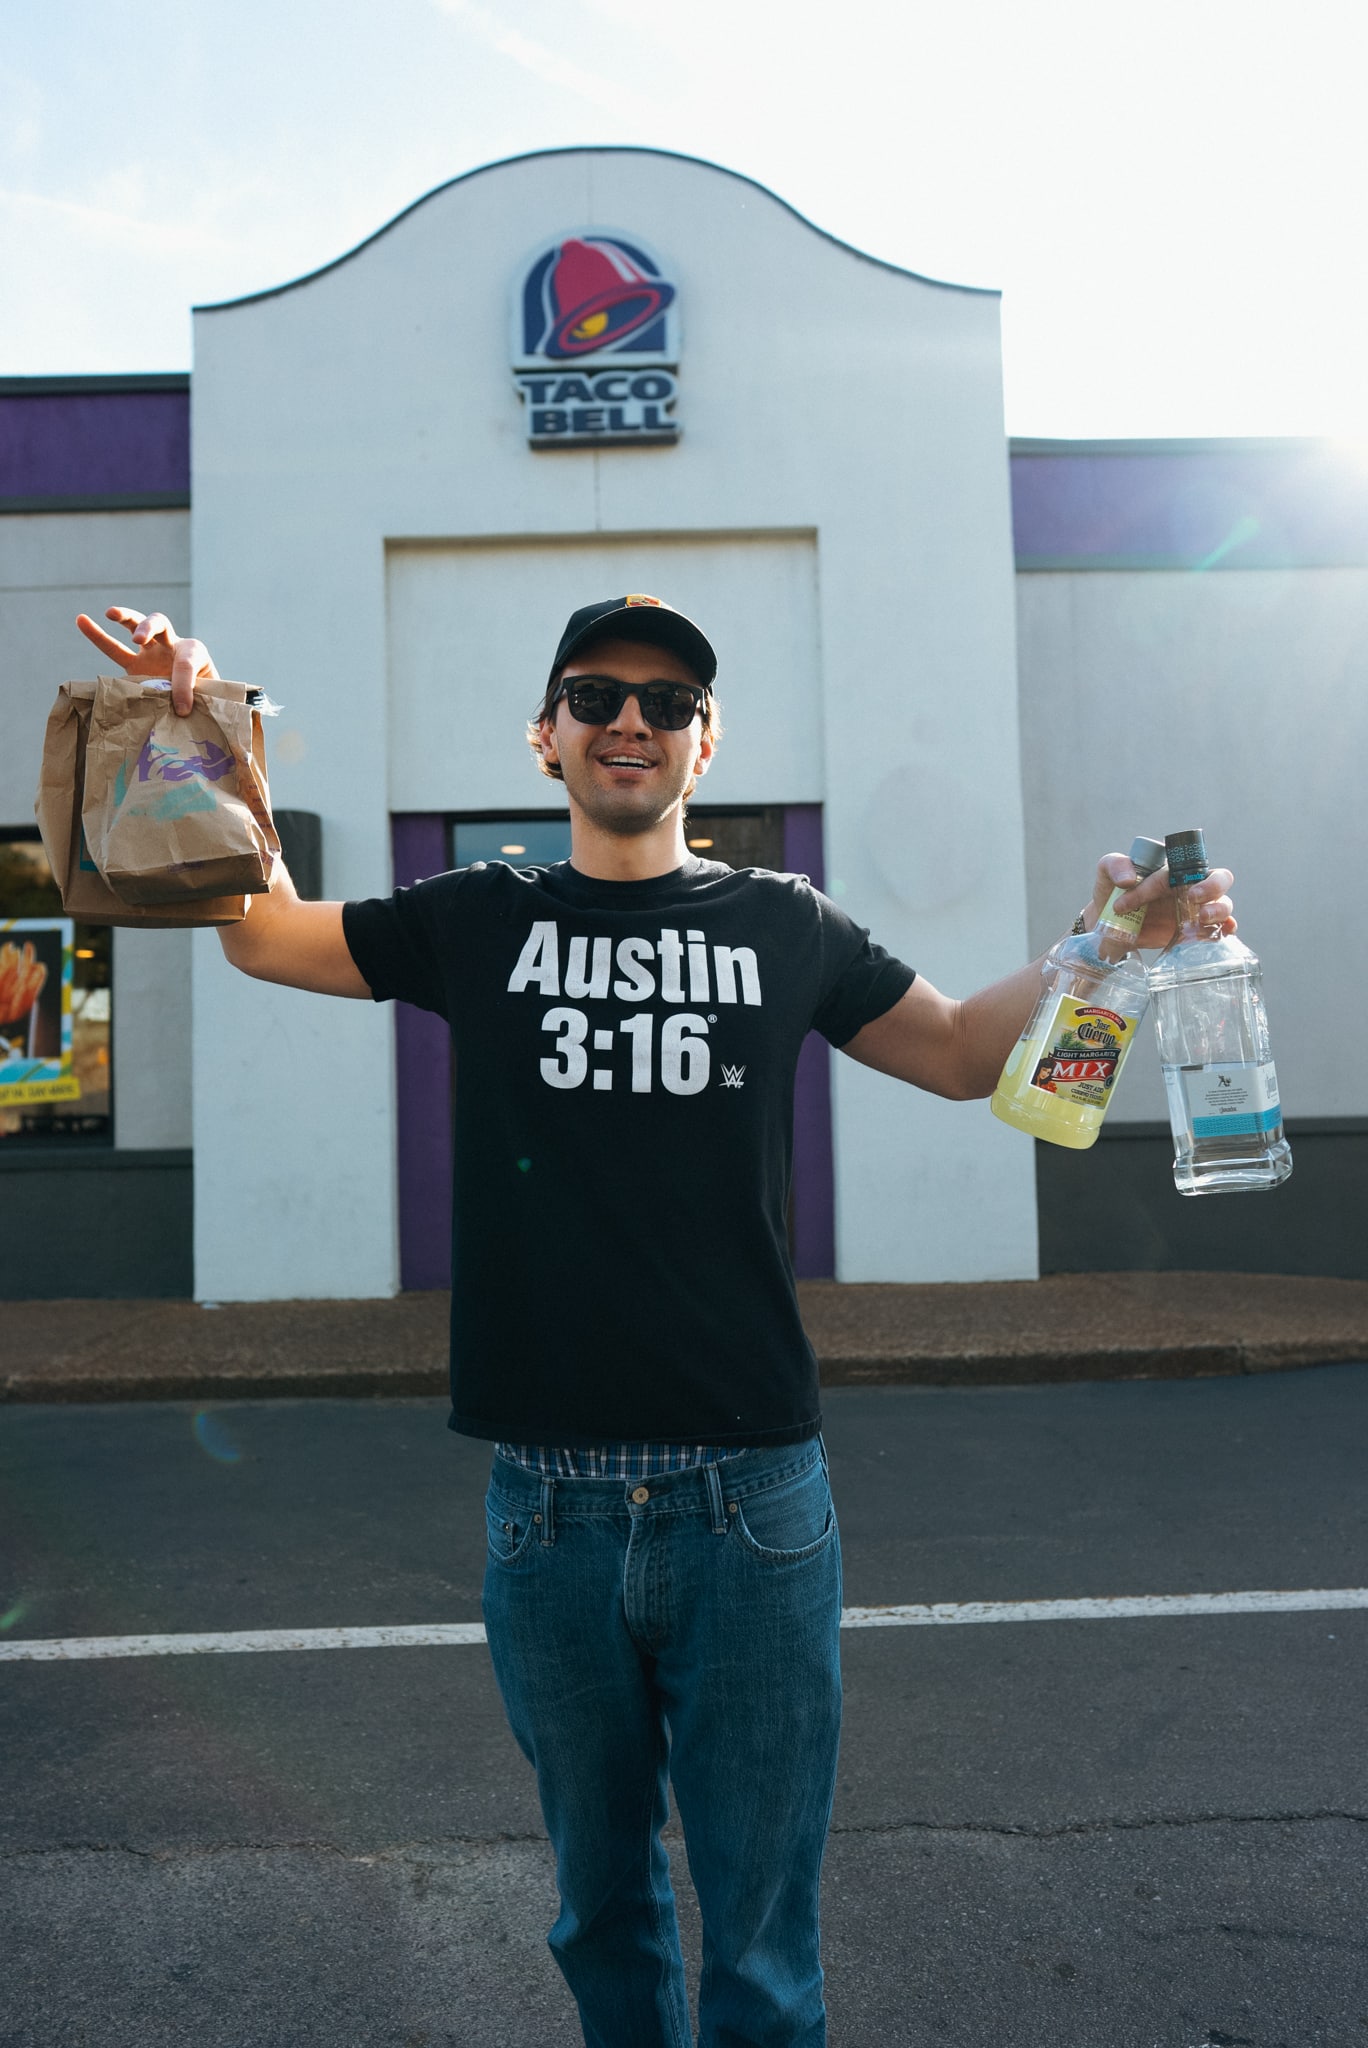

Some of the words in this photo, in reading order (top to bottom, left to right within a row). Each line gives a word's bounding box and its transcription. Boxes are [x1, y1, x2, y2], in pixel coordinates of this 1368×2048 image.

[520, 376, 672, 404] TACO
[532, 406, 676, 434] BELL
[507, 920, 762, 1007] Austin
[1078, 1023, 1115, 1045] Cuervo
[540, 1006, 711, 1096] 3:16
[1052, 1061, 1109, 1077] MIX
